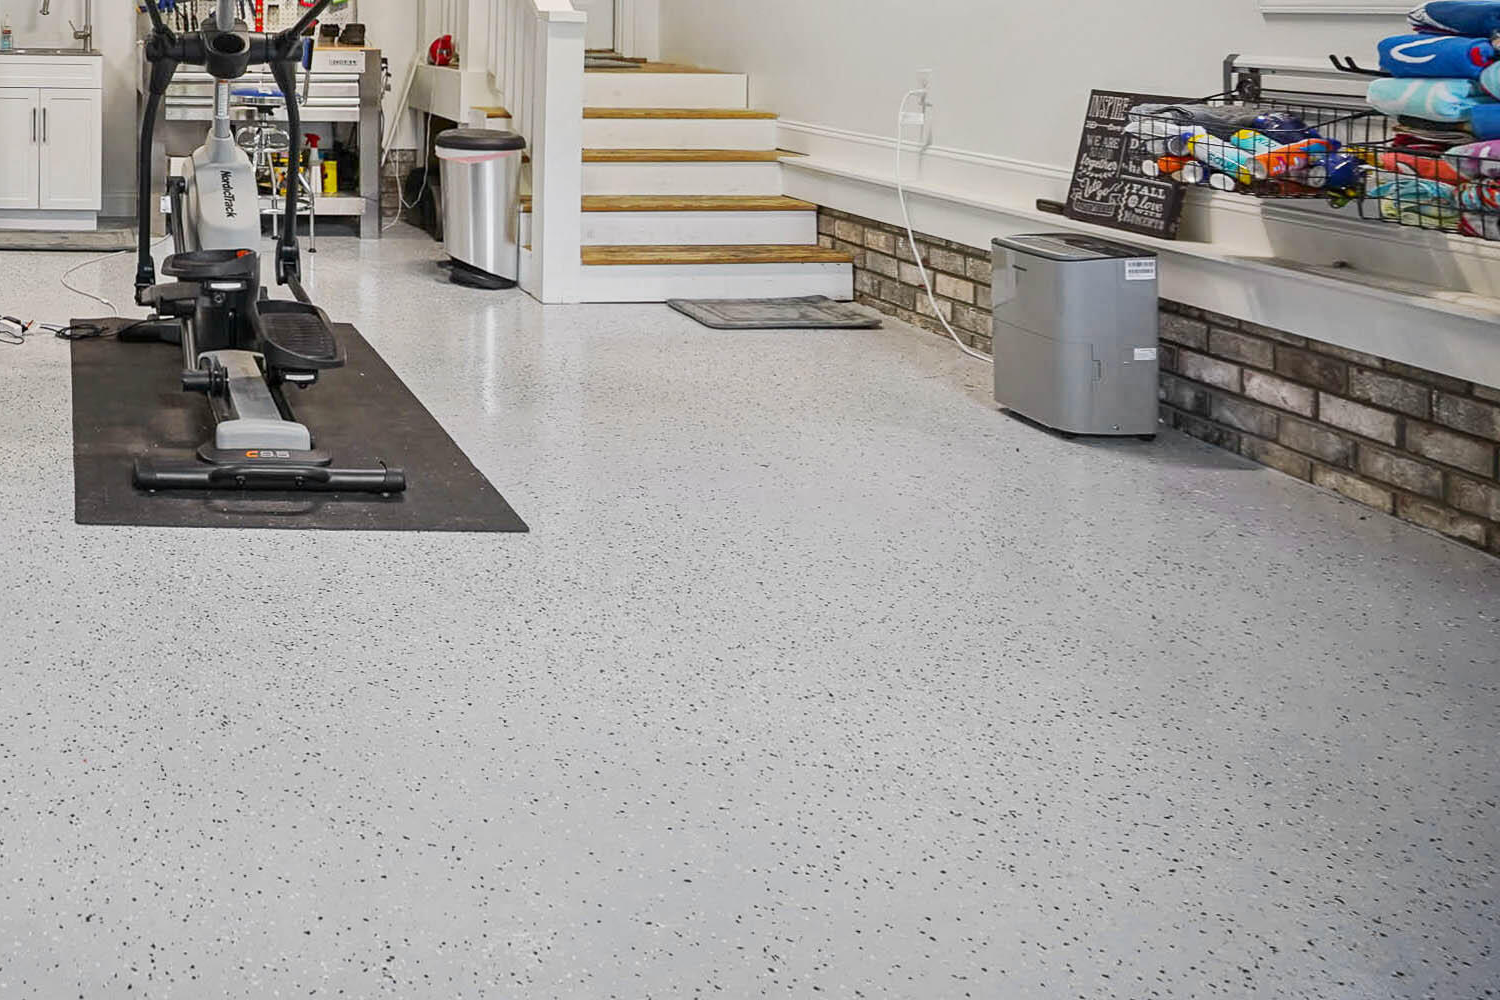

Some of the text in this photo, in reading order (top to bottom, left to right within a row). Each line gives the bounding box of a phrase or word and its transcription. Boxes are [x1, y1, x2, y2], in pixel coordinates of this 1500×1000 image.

[1088, 94, 1130, 120] INSPIRE
[220, 170, 237, 218] NordicTrack
[1131, 183, 1166, 200] FALL
